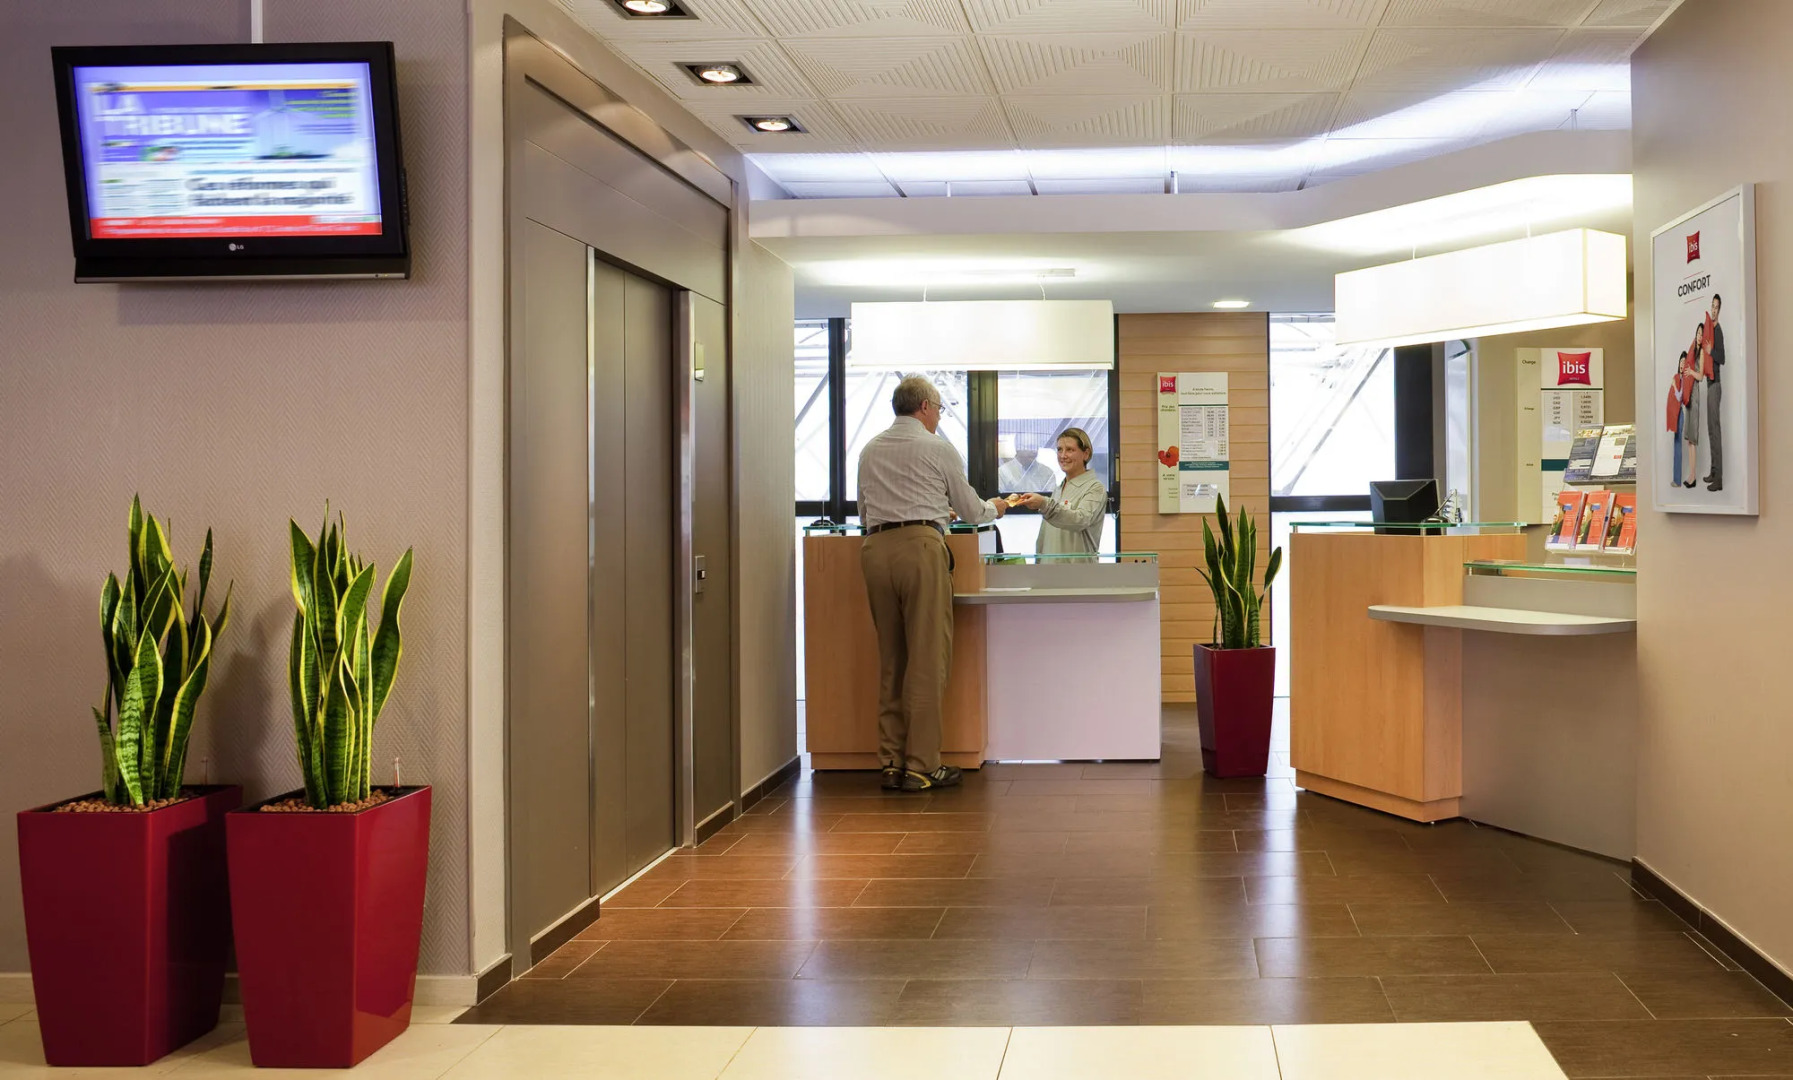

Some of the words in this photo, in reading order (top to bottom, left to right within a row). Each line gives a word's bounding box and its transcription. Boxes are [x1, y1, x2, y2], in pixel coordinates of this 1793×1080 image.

[1689, 240, 1698, 254] ibis
[1677, 274, 1711, 297] CONFORT
[1562, 361, 1586, 374] ibis
